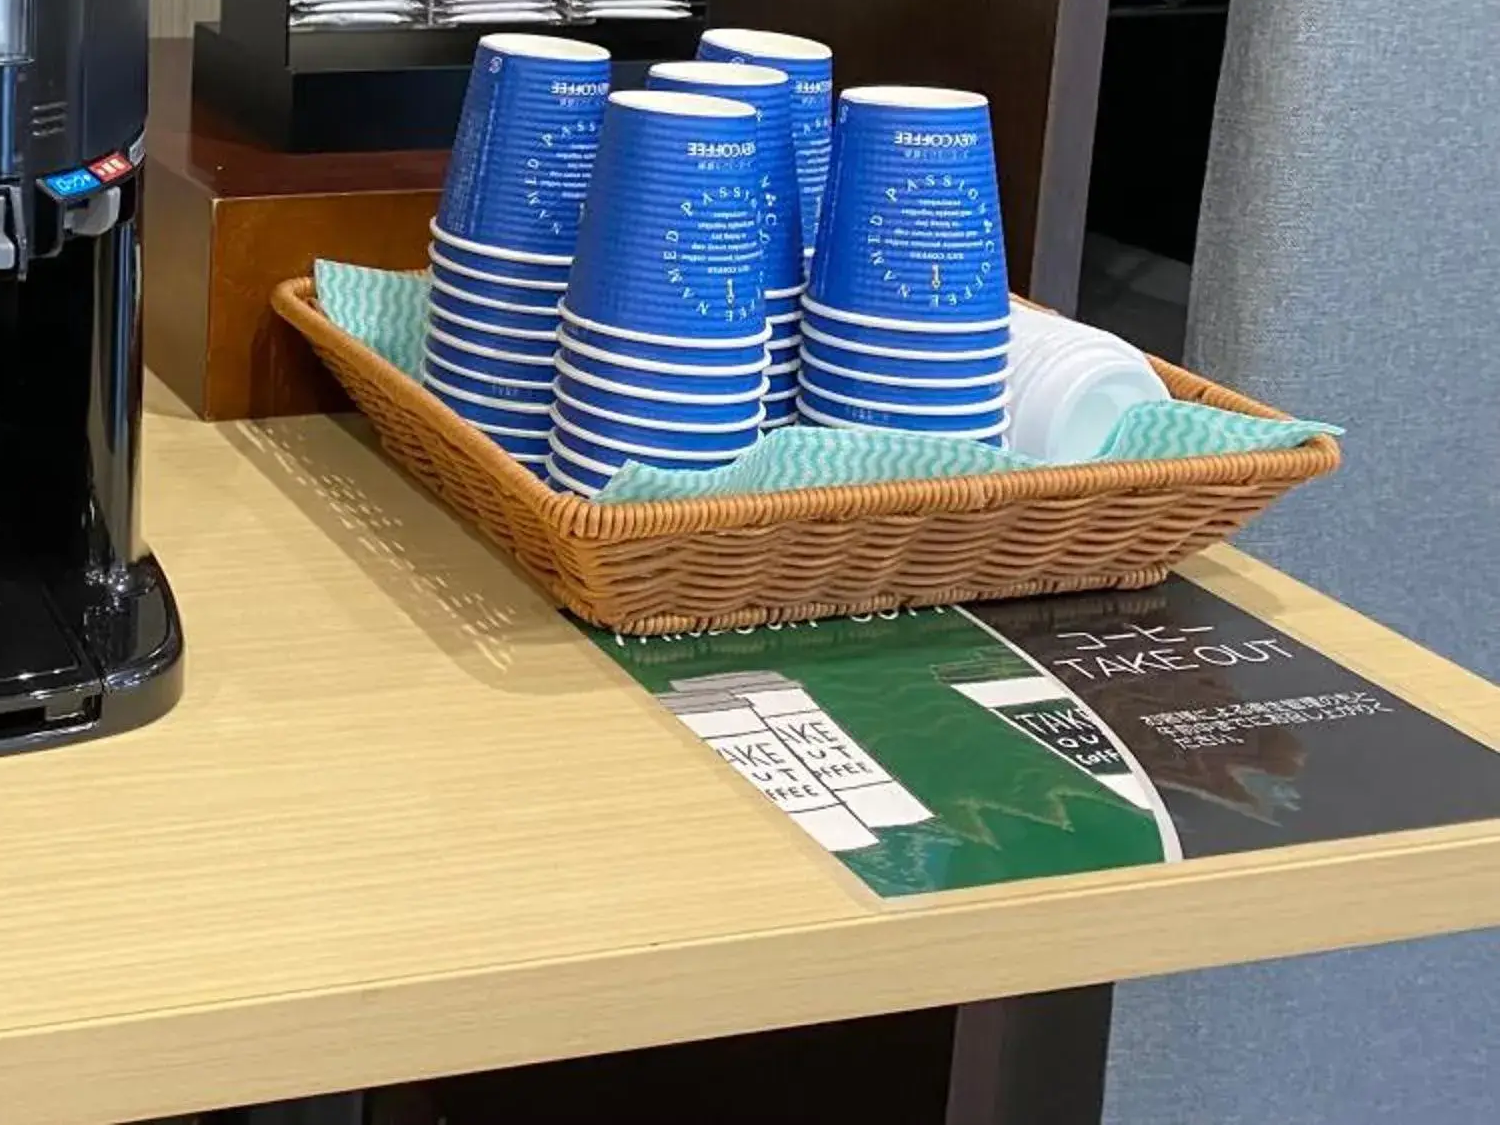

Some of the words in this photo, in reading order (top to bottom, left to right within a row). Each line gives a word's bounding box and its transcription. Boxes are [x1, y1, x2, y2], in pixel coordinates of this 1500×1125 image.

[1057, 623, 1214, 650] コーヒー
[1053, 649, 1199, 679] TAKE
[1193, 639, 1293, 666] OUT
[775, 722, 838, 744] AKE
[716, 742, 787, 767] AKE
